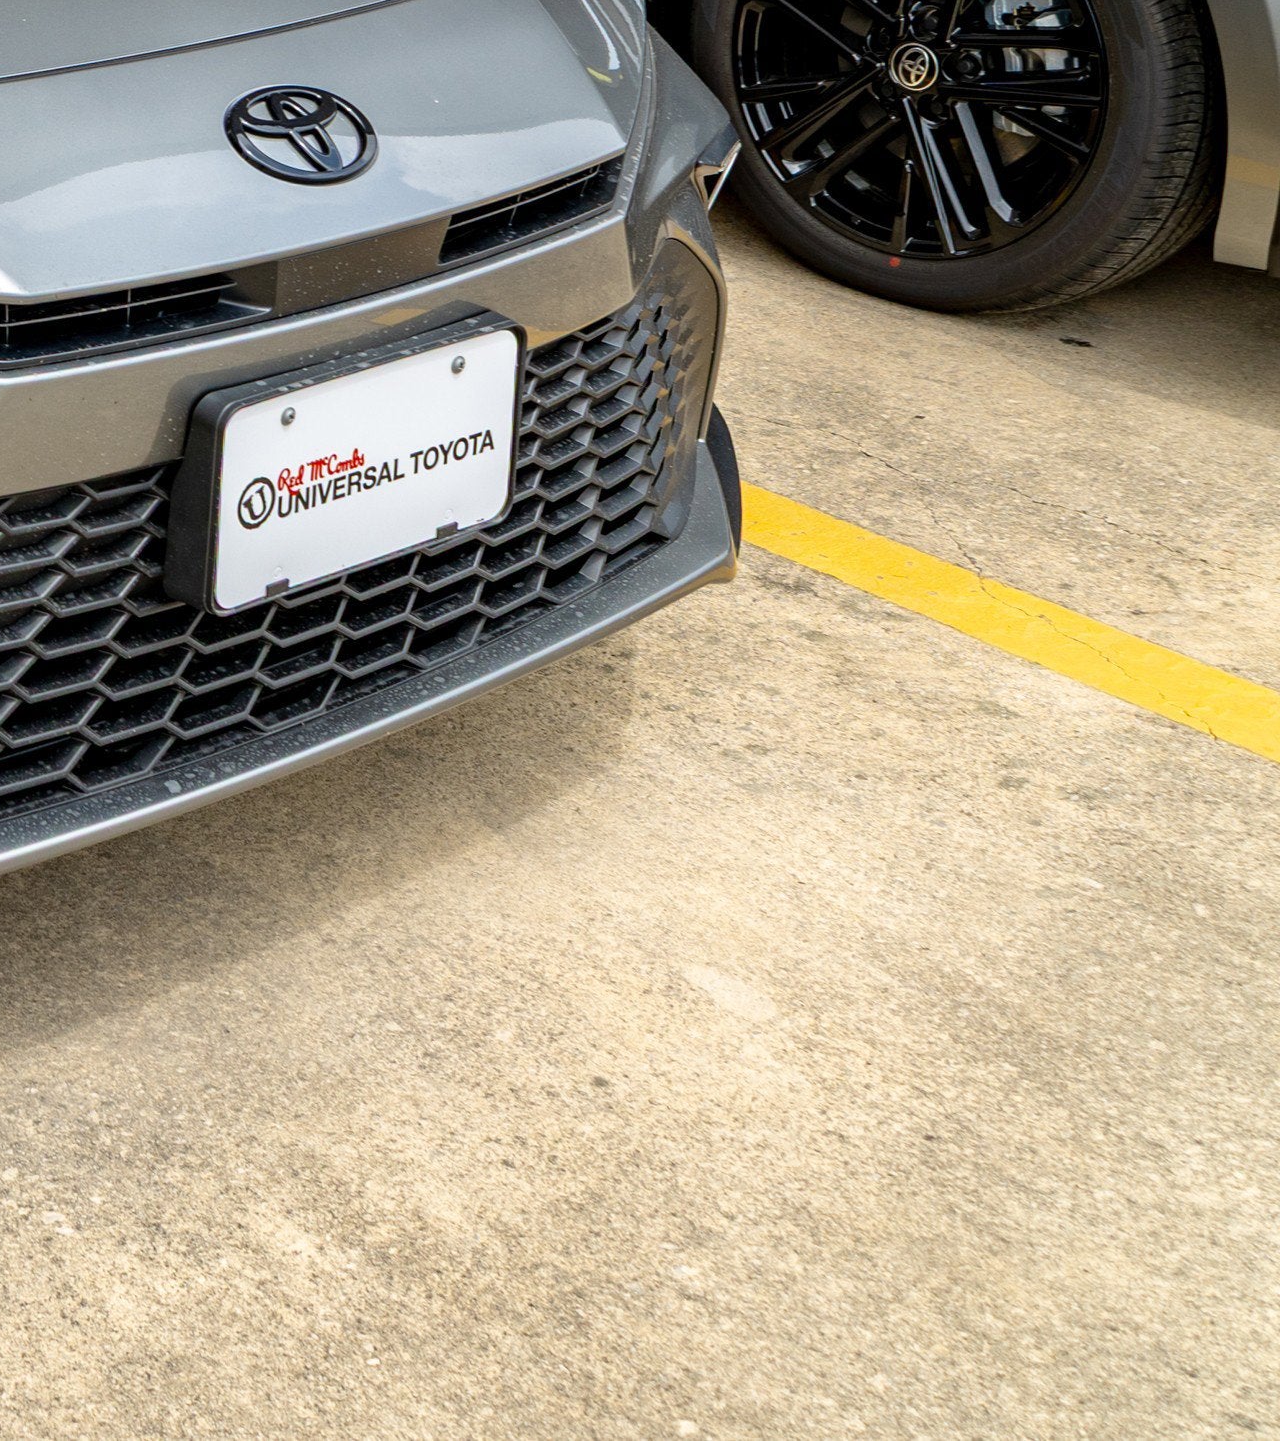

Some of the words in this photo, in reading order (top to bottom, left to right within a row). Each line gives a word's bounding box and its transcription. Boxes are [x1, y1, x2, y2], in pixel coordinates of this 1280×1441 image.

[277, 465, 305, 496] Red
[278, 458, 405, 518] UNIVERSAL
[410, 429, 494, 475] TOYOTA
